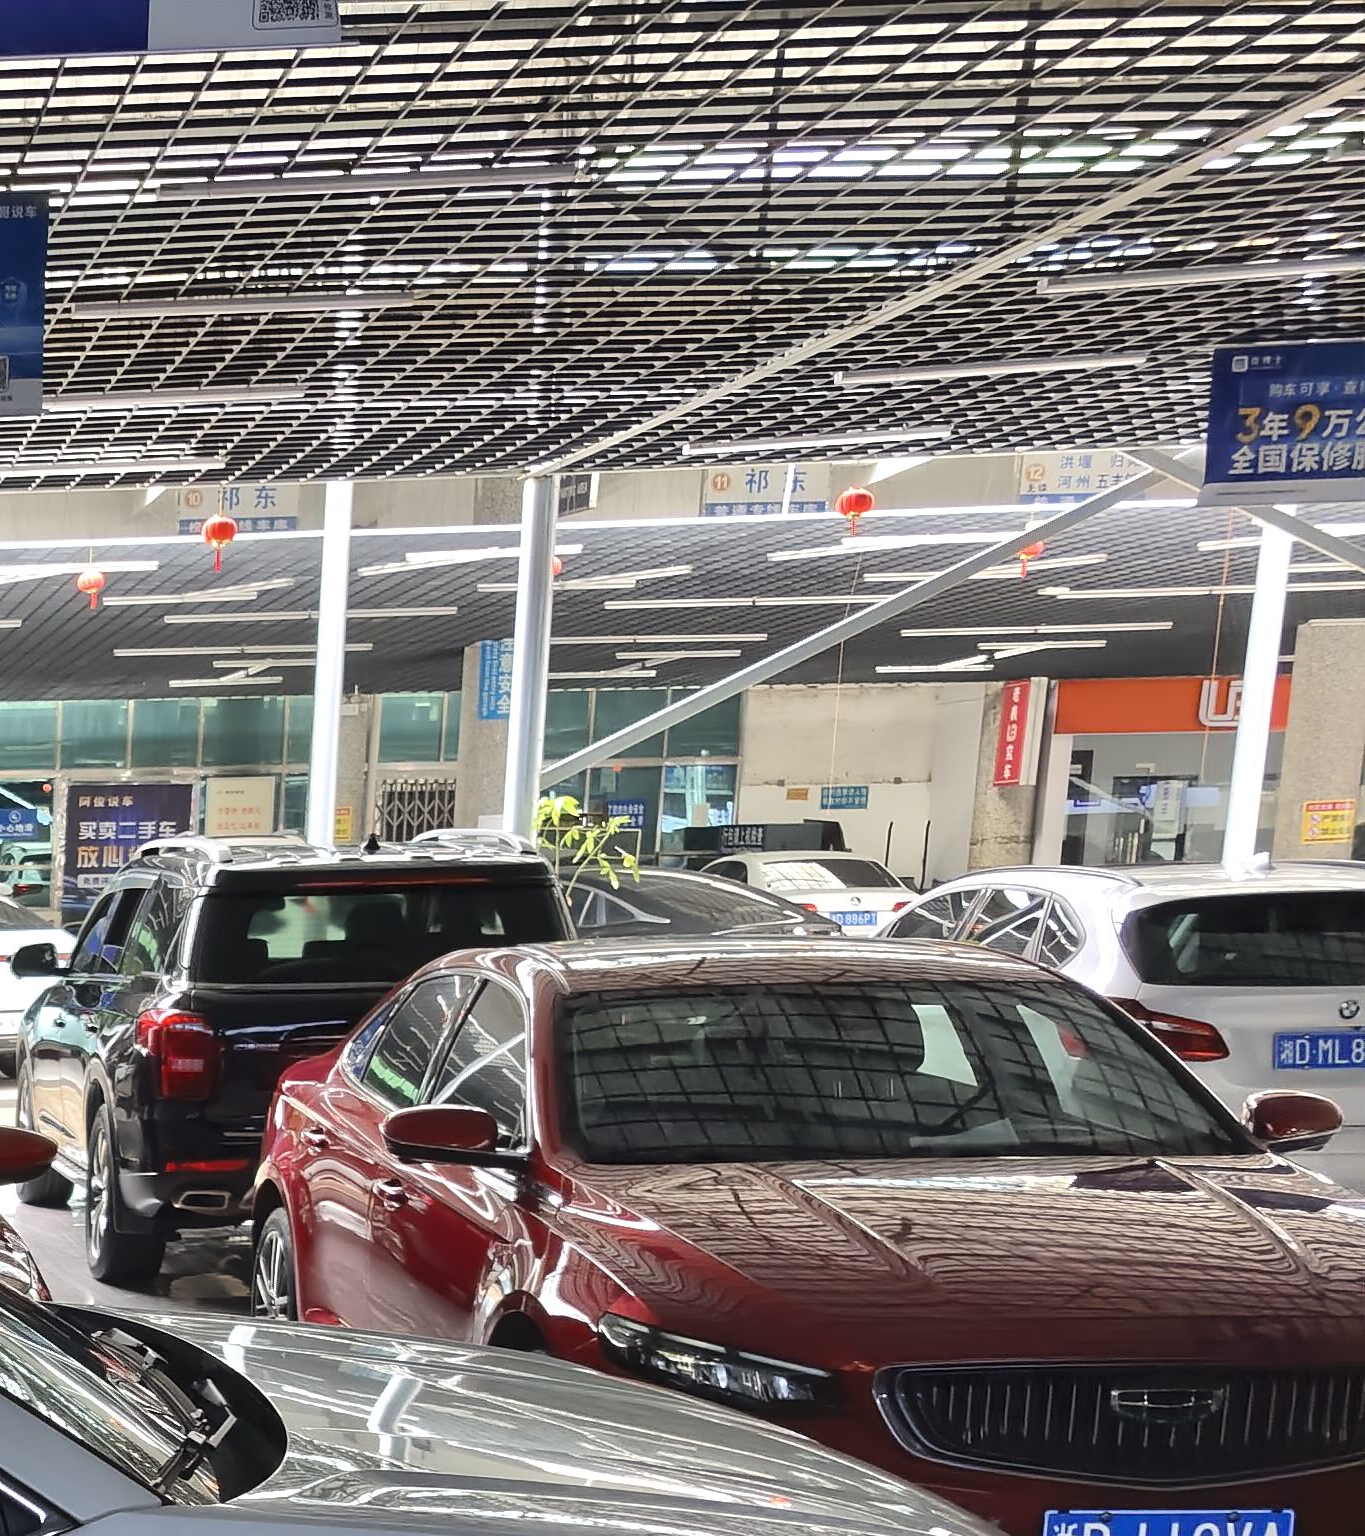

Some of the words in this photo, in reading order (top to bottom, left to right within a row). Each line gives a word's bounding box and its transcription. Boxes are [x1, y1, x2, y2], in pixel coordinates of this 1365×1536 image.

[1029, 467, 1043, 480] 12
[714, 476, 729, 490] 11
[187, 492, 200, 506] 10
[218, 486, 277, 510] 祁东
[78, 795, 134, 807] 阿俊说车
[78, 820, 176, 840] 买卖二手车
